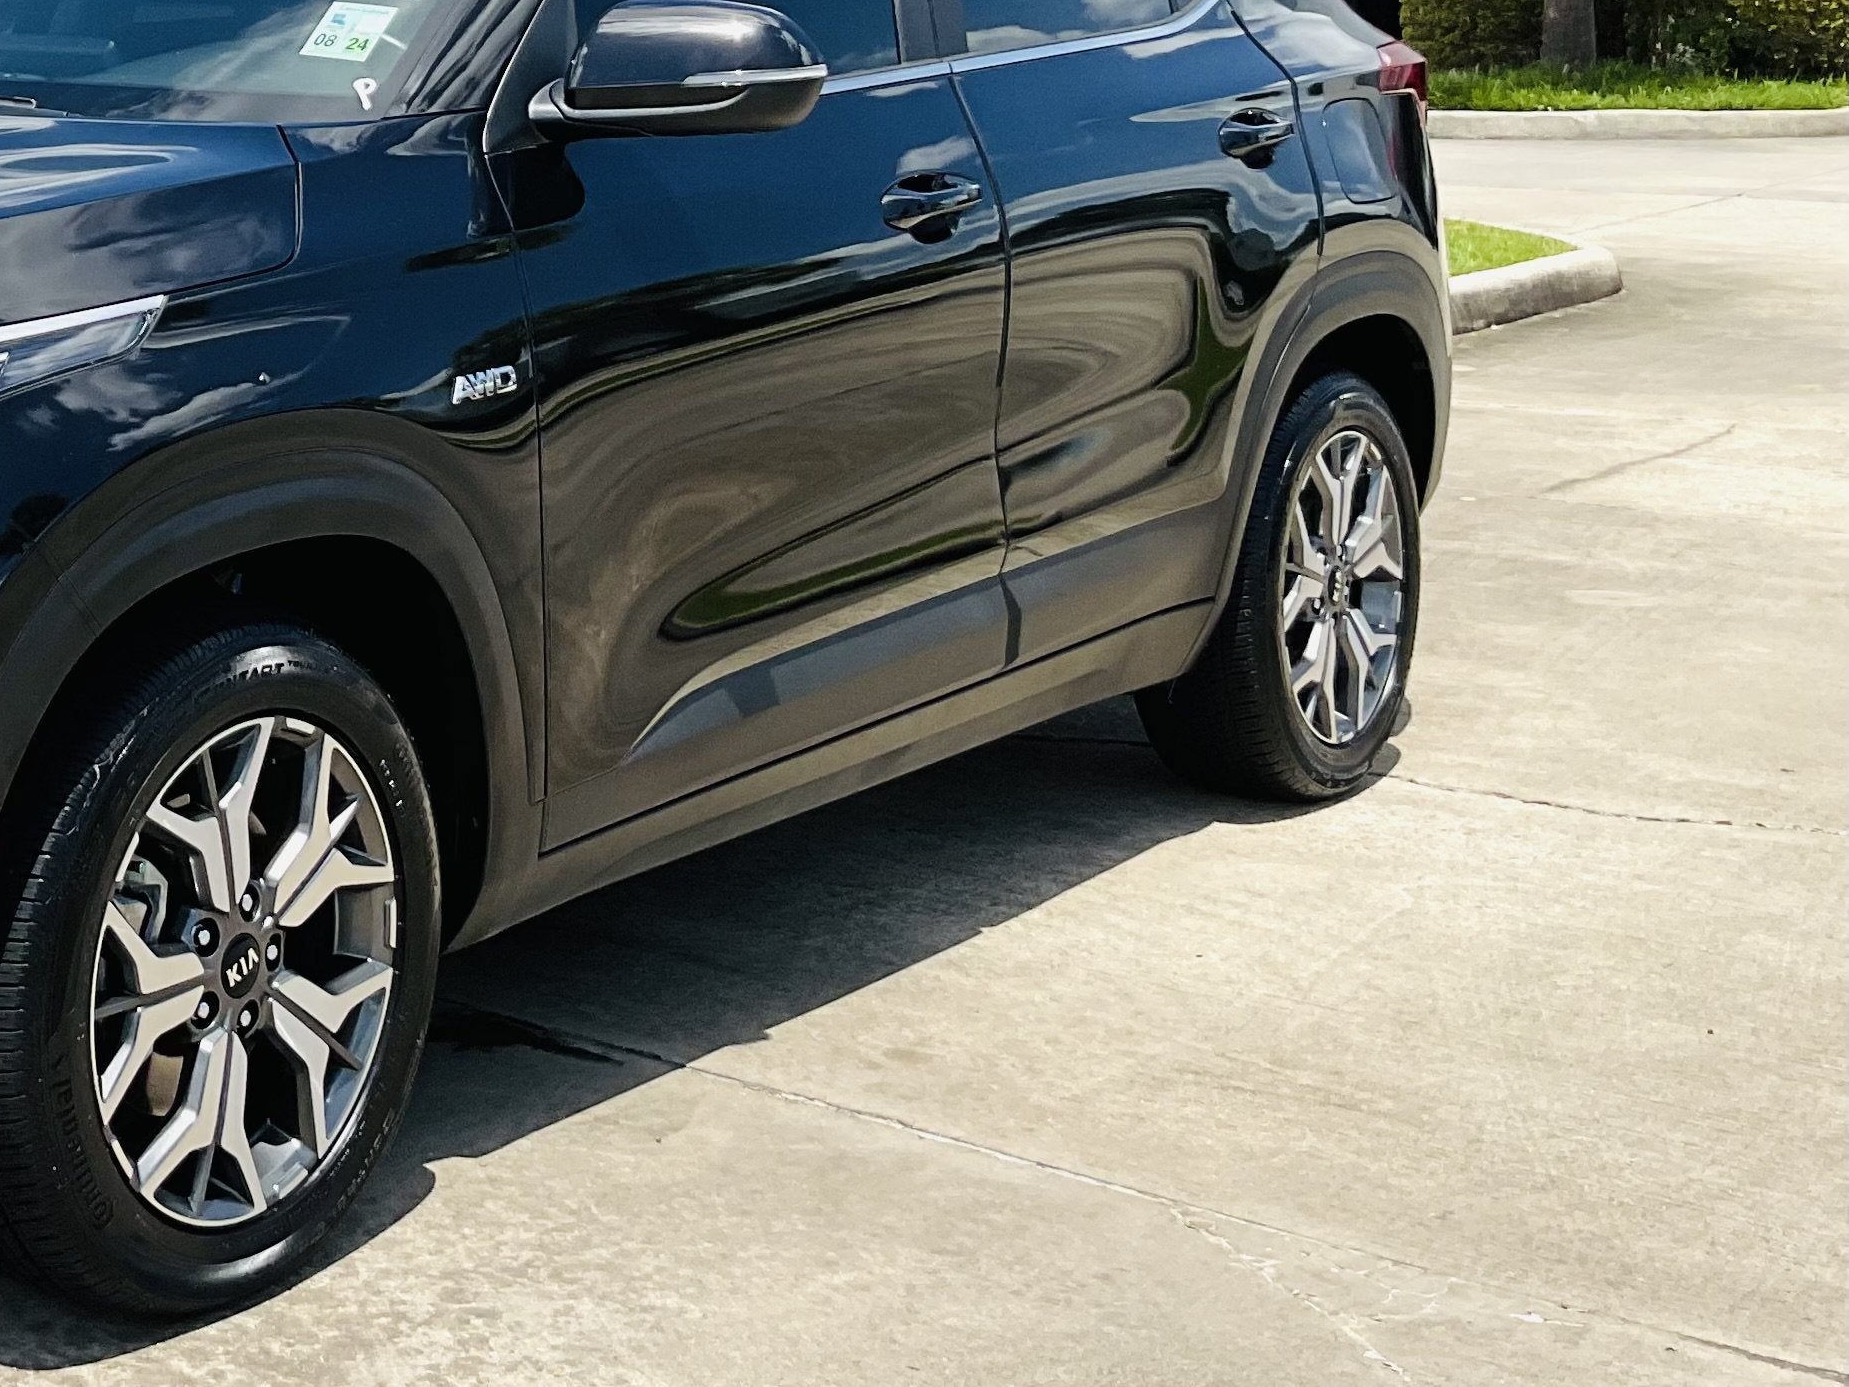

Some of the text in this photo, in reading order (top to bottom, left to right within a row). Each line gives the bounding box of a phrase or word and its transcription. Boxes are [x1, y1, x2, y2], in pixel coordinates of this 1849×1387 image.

[313, 33, 370, 51] 08 24
[452, 365, 518, 404] AWD
[225, 947, 260, 988] KIA
